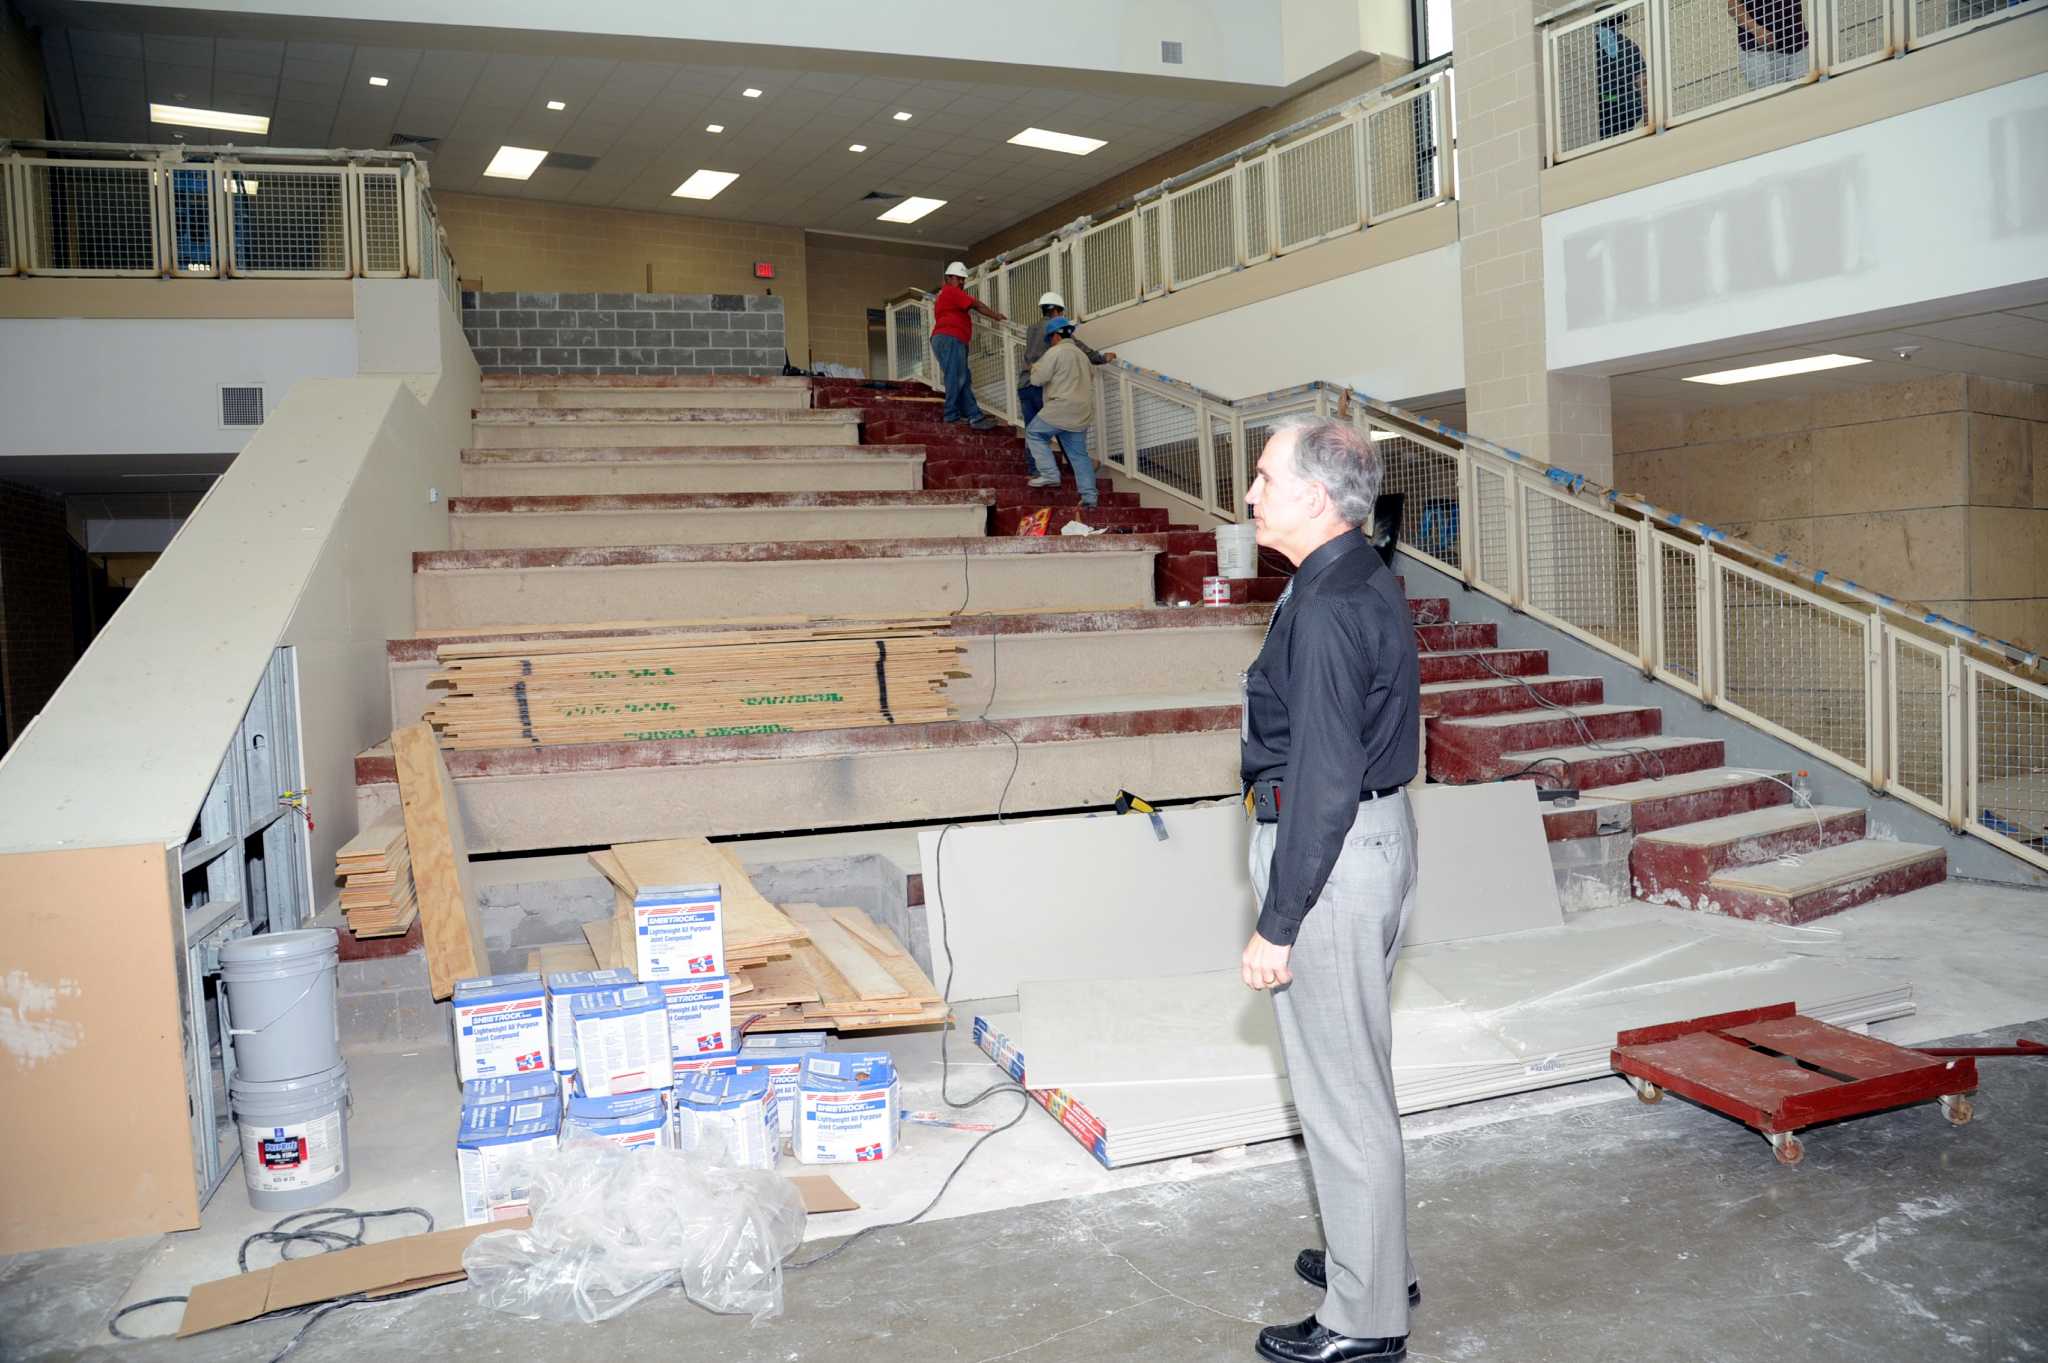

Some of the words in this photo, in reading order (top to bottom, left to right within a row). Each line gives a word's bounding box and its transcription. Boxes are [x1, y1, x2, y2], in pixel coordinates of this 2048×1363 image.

[648, 913, 696, 925] SHEETROCK
[472, 1012, 521, 1025] SHEETROCK
[817, 1102, 865, 1113] SHEETROCK
